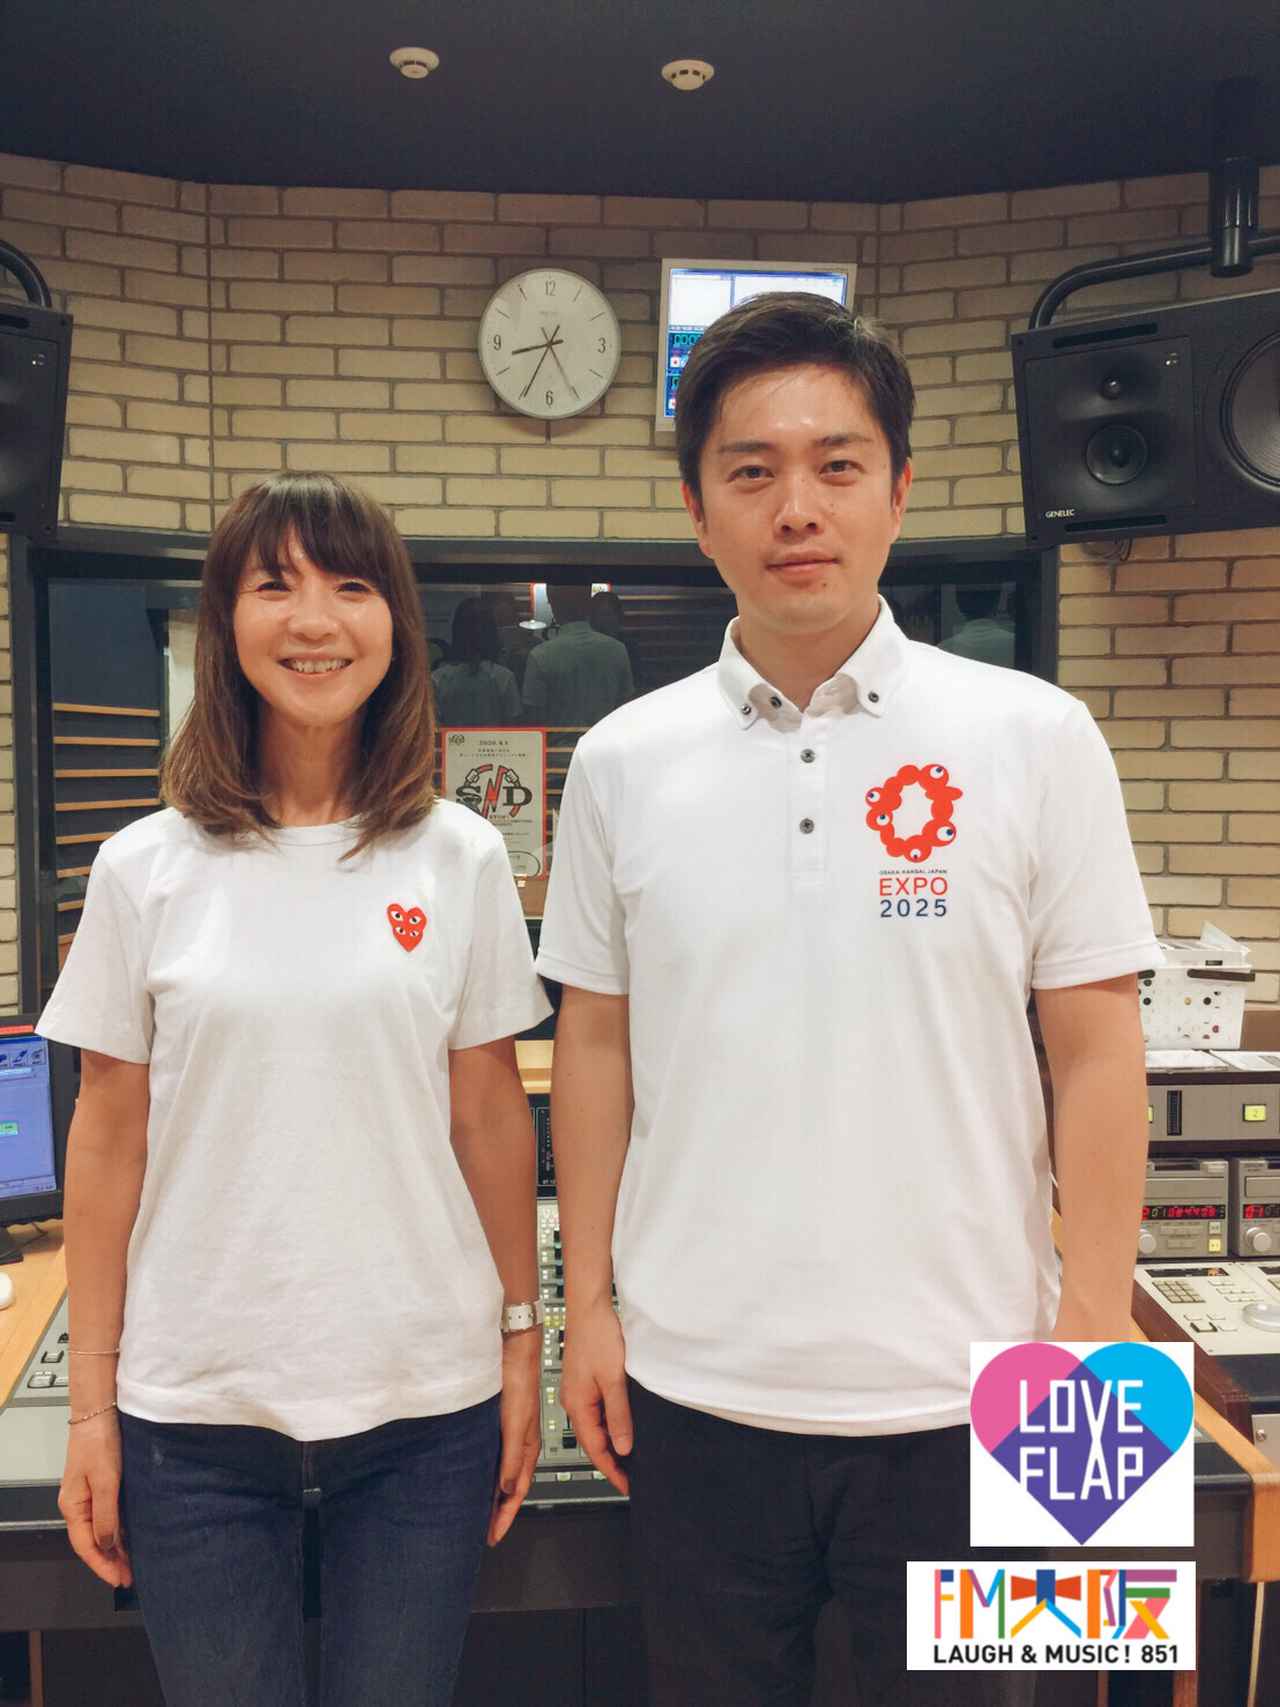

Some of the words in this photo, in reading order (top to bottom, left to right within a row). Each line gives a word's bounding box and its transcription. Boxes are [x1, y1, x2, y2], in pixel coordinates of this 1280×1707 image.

[545, 280, 556, 296] 12
[493, 335, 501, 351] 9
[599, 337, 606, 353] 3
[545, 390, 553, 406] 6
[879, 877, 948, 896] EXPO
[880, 898, 947, 918] 2025
